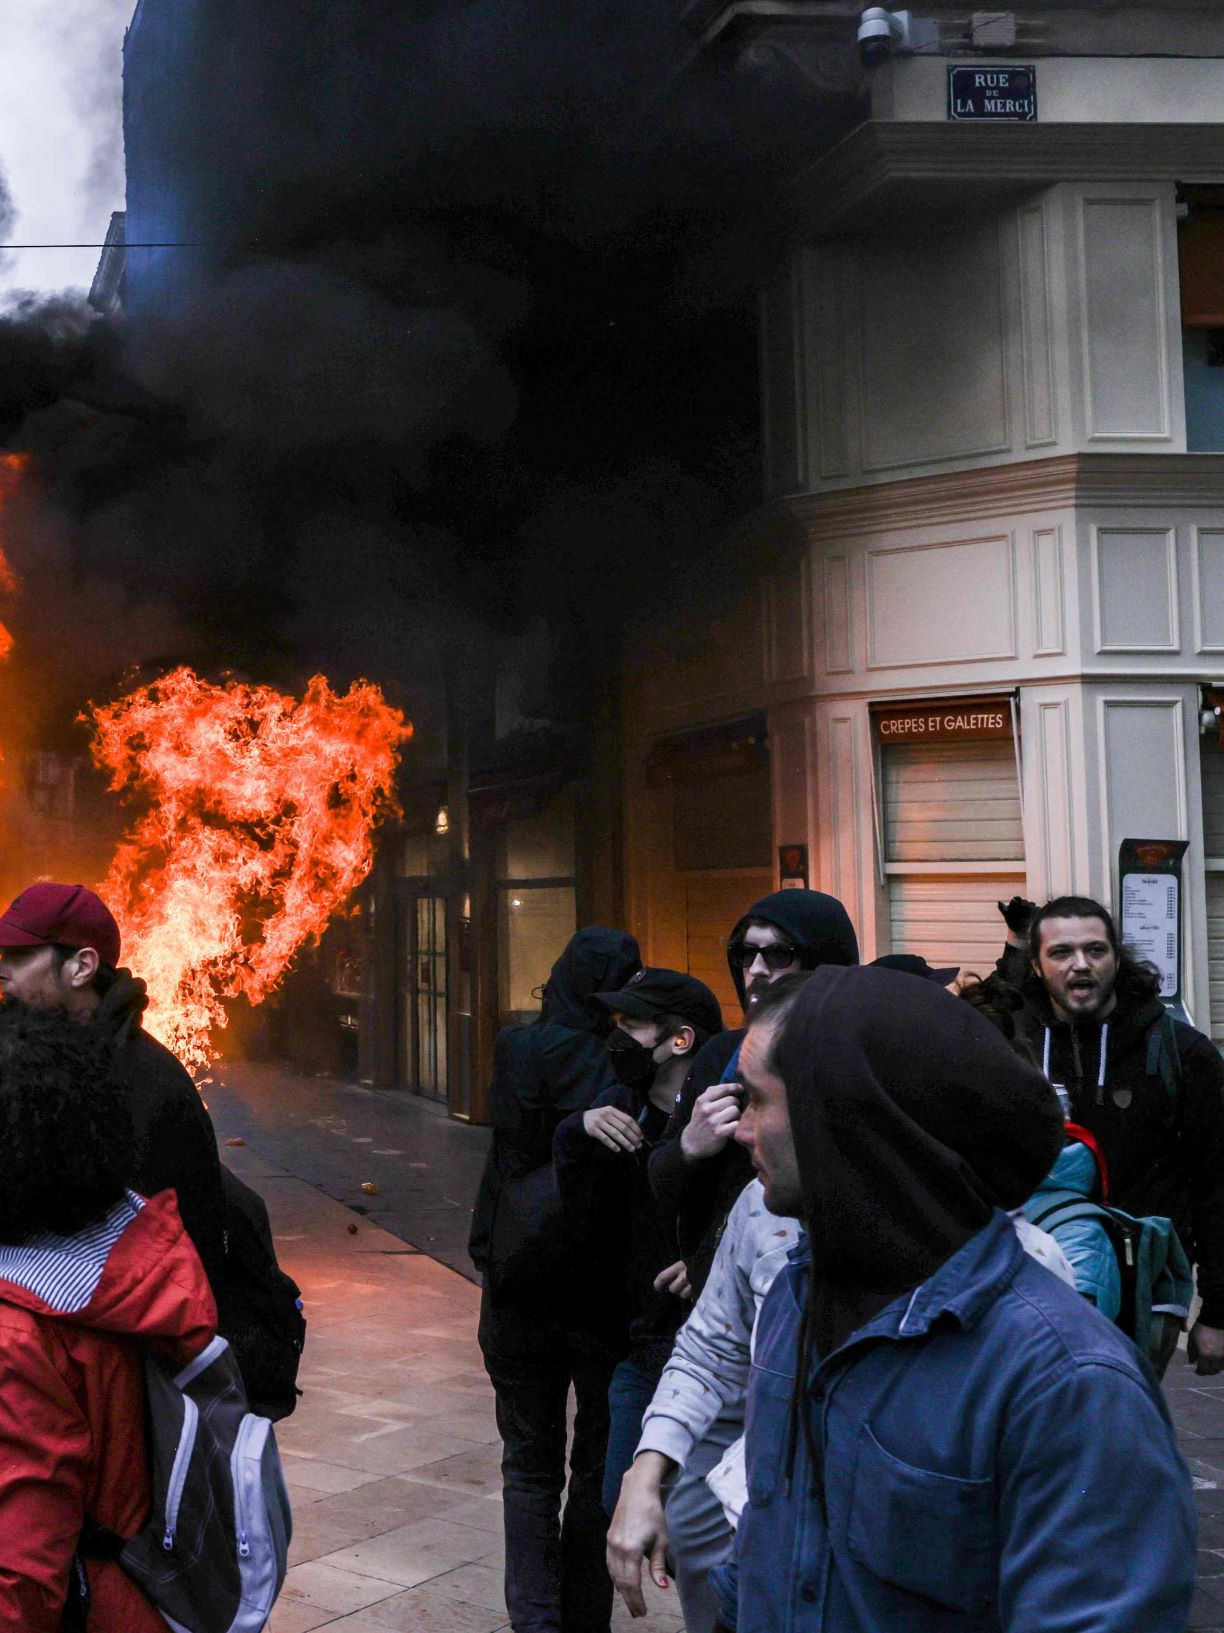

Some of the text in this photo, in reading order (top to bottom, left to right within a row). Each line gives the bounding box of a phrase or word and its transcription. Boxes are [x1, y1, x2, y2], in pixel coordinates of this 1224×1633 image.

[974, 74, 1009, 88] RUE
[985, 89, 999, 97] DE
[957, 99, 1029, 113] LA MERCI
[880, 713, 1003, 735] CREPES ET GALETTES
